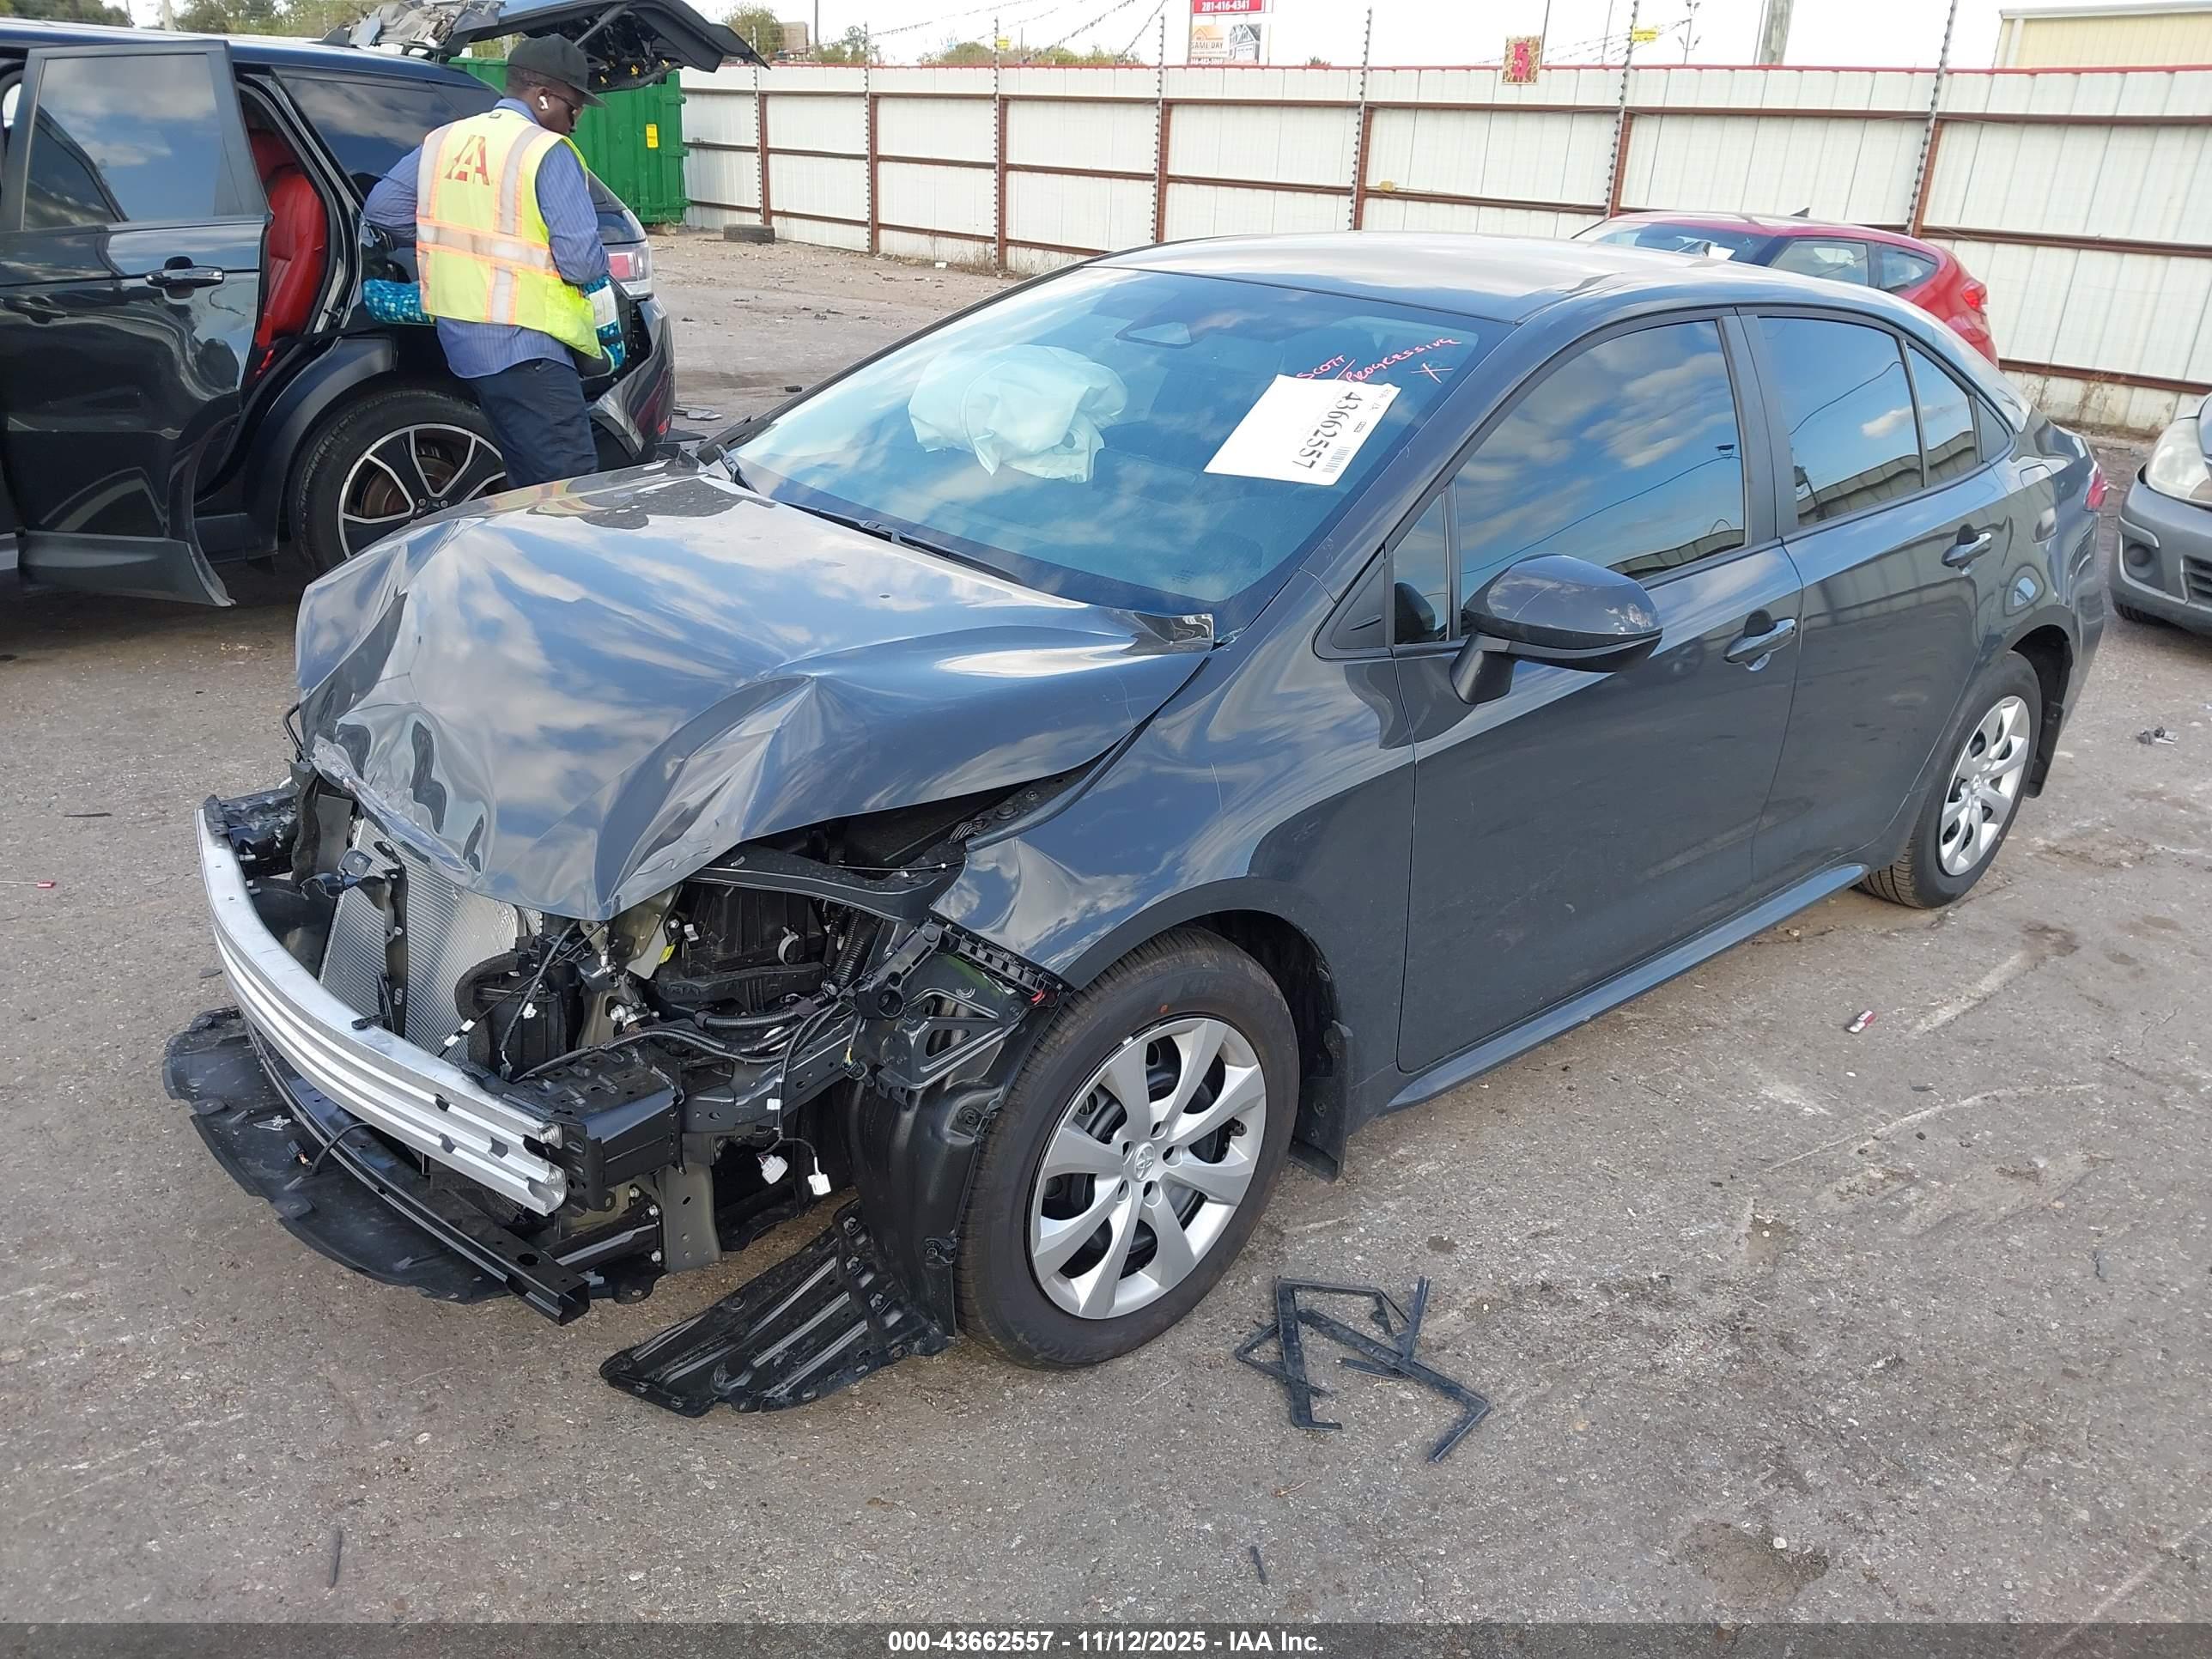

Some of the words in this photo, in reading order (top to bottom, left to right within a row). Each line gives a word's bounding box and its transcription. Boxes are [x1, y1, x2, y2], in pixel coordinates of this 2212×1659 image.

[1211, 40, 1224, 49] DAY
[1296, 354, 1346, 380] SCOTT
[1291, 391, 1364, 470] 43662557
